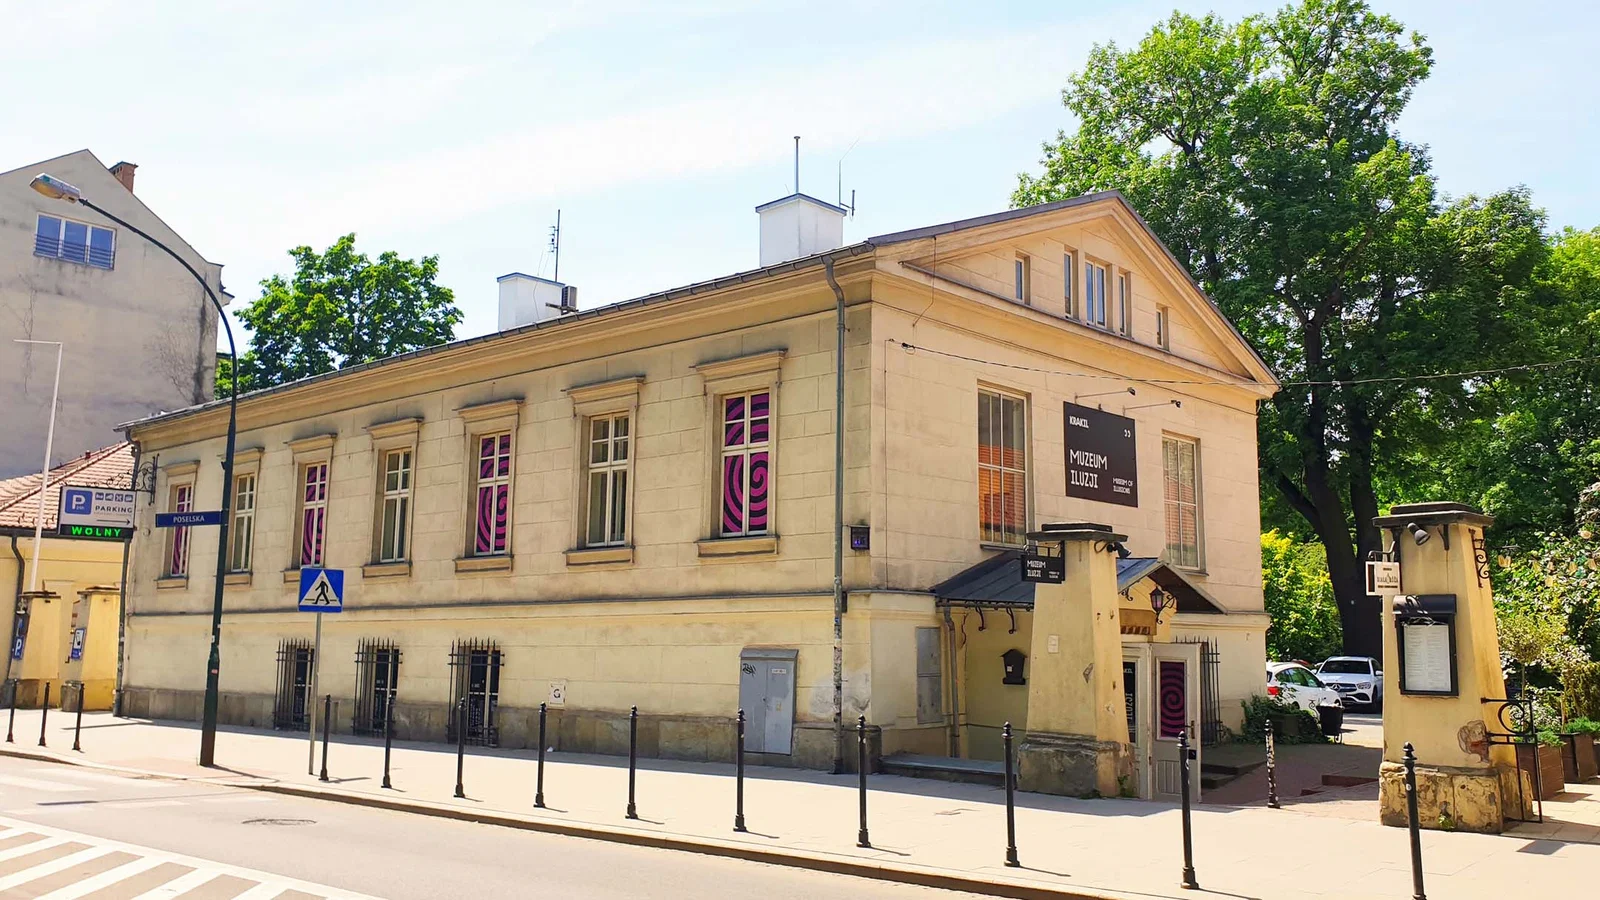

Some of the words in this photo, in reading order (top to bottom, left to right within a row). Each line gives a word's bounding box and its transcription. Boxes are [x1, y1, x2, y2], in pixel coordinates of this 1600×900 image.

[1069, 449, 1107, 470] MUZEUM
[1070, 470, 1098, 488] ILUZJI
[71, 494, 86, 510] P
[95, 505, 133, 514] PARKING
[173, 515, 205, 524] POSELSKA
[71, 525, 121, 537] WOLNY
[1026, 560, 1047, 569] MUZEUM
